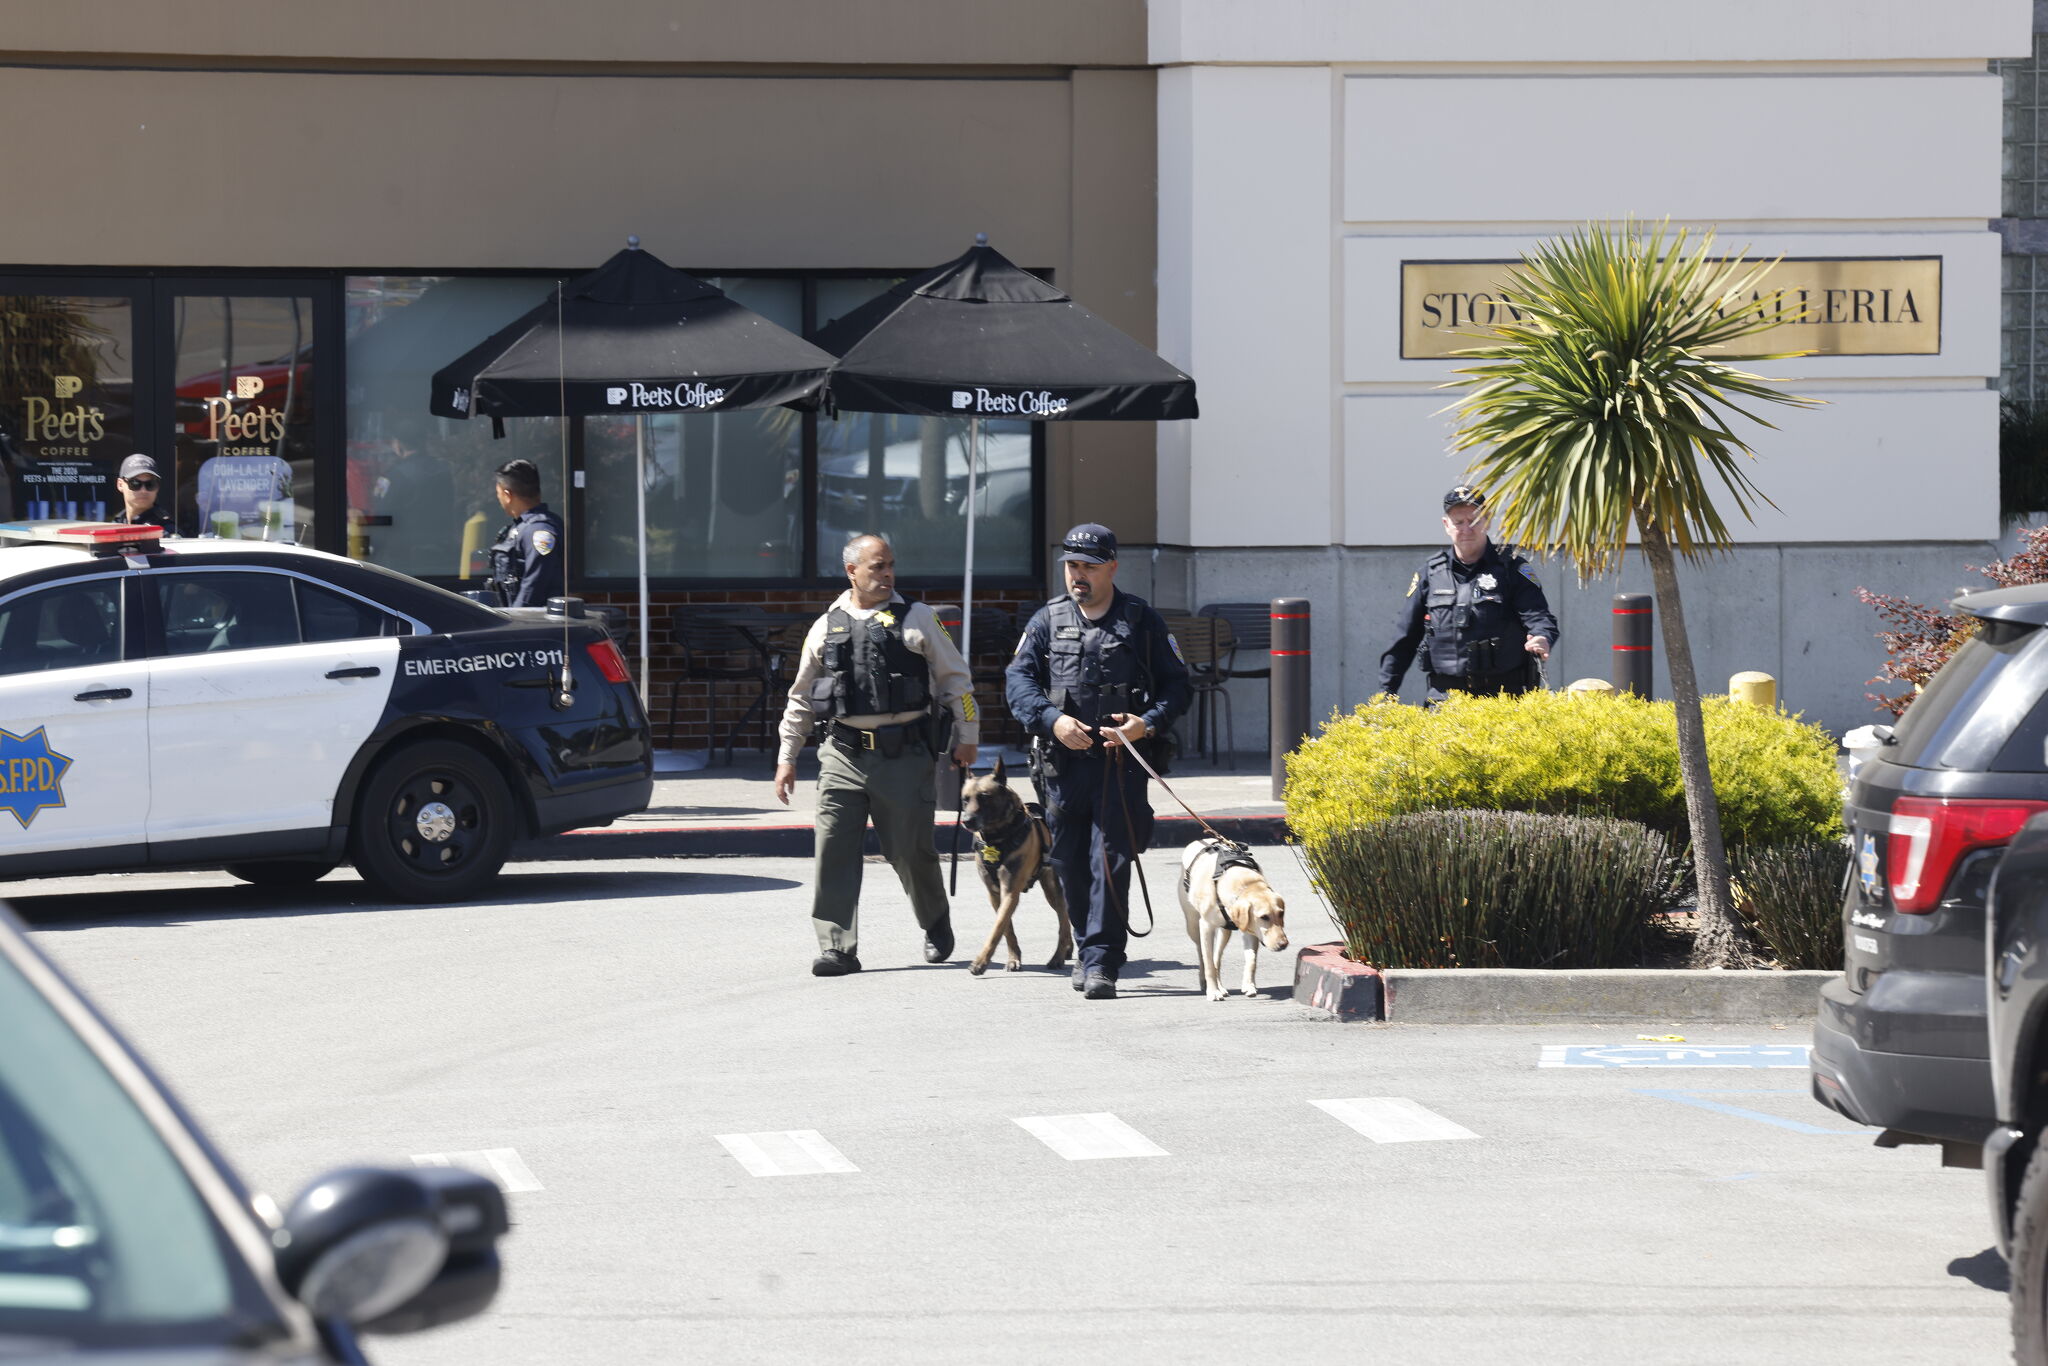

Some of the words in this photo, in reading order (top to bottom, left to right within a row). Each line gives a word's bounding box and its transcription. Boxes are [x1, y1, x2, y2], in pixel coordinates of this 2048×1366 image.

[1718, 288, 1922, 325] ALLERIA
[674, 382, 725, 409] Coffee
[1018, 390, 1068, 416] Coffee
[40, 446, 89, 456] COFFEE
[222, 446, 271, 456] COFFEE
[217, 478, 270, 492] LAVENDER
[404, 652, 526, 676] EMERGENCY
[535, 649, 564, 666] 911
